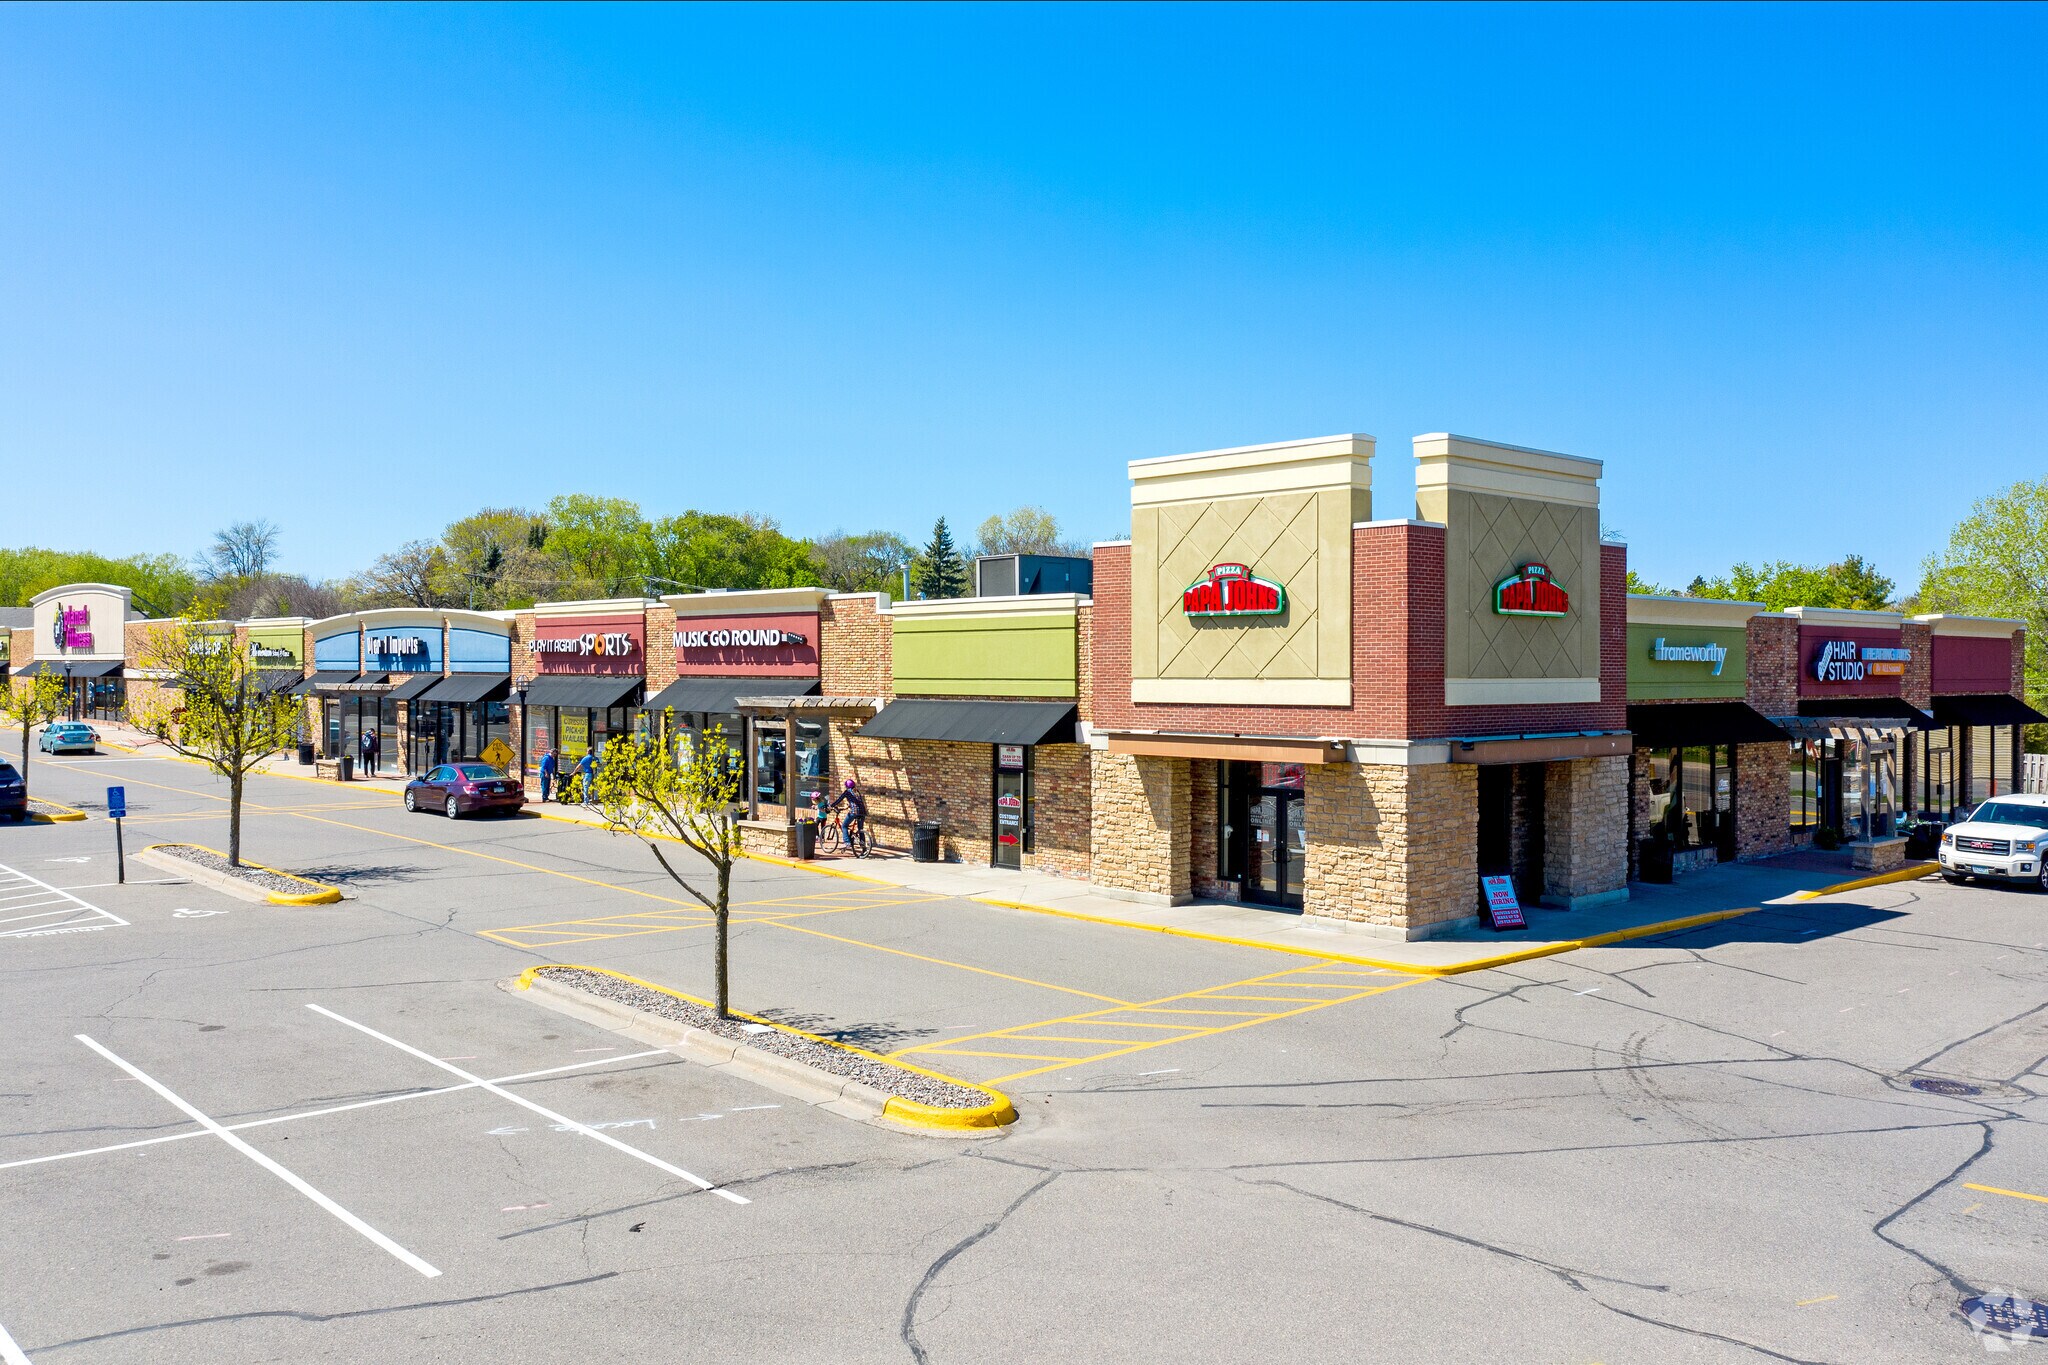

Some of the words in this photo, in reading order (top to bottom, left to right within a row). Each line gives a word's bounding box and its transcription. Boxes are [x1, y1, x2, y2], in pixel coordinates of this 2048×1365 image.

[1215, 566, 1242, 576] PIZZA
[1527, 566, 1546, 576] PIZZA
[1183, 581, 1223, 613] PAPA
[1224, 579, 1278, 612] JOHNS
[1502, 580, 1533, 611] PAPA
[1533, 580, 1569, 613] JOHNS
[384, 635, 388, 654] 1
[528, 640, 546, 653] PLAY
[546, 640, 554, 653] IT
[553, 639, 578, 653] AGAIN
[579, 633, 632, 656] SPORTS
[672, 631, 709, 648] MUSIC
[709, 629, 730, 647] GO
[731, 629, 781, 647] ROUND
[1655, 637, 1727, 676] frameworthy
[1832, 641, 1856, 660] HAIR
[1828, 661, 1864, 681] STUDIO
[565, 726, 586, 735] PICK-UP
[998, 813, 1020, 821] CUSTOMER
[999, 819, 1019, 827] ENTRANCE
[1969, 840, 1994, 850] GMC
[1492, 890, 1509, 899] NOW
[1490, 897, 1516, 906] HIRING
[16, 926, 105, 939] PARKING
